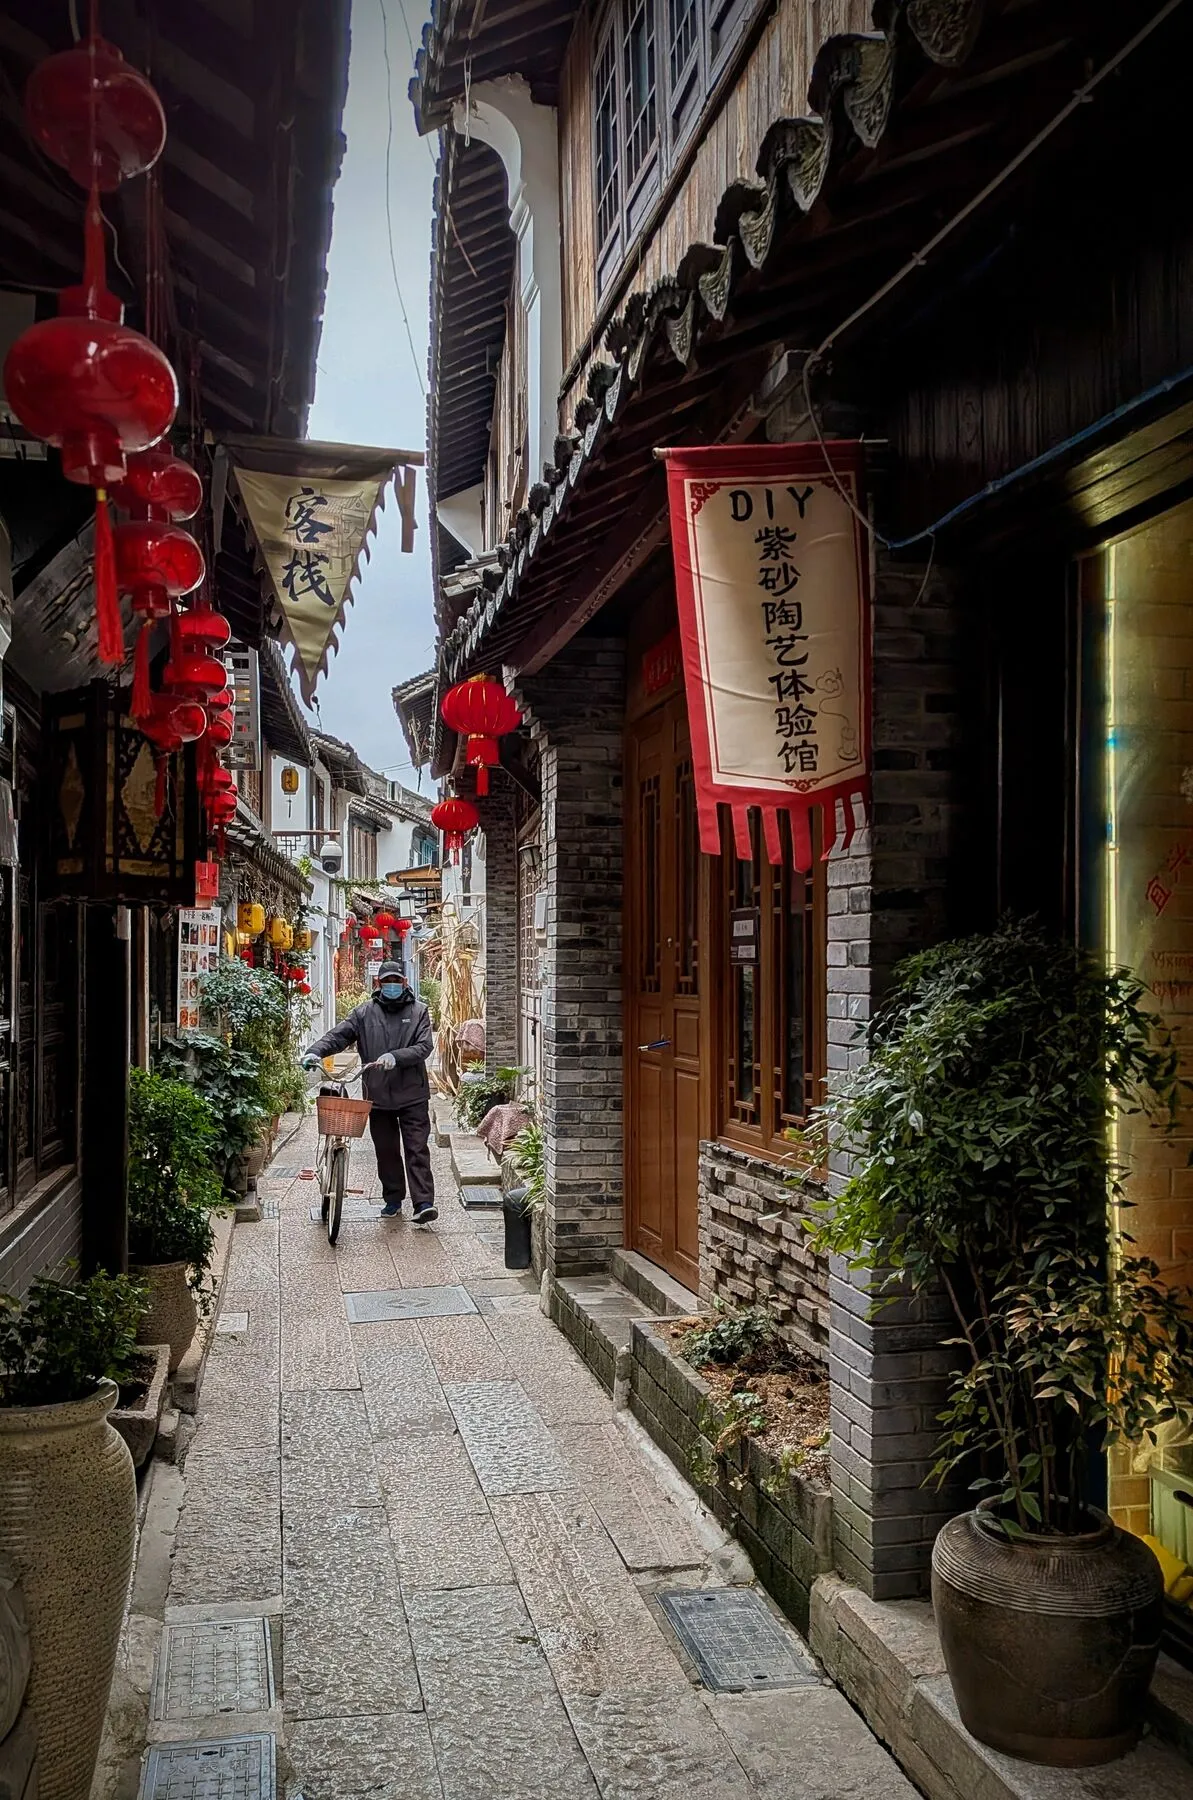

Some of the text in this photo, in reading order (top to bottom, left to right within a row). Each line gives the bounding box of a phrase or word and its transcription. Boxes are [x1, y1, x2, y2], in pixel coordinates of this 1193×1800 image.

[281, 486, 336, 606] 客栈
[728, 486, 815, 522] DIY
[753, 526, 819, 774] 紫砂陶艺体验馆
